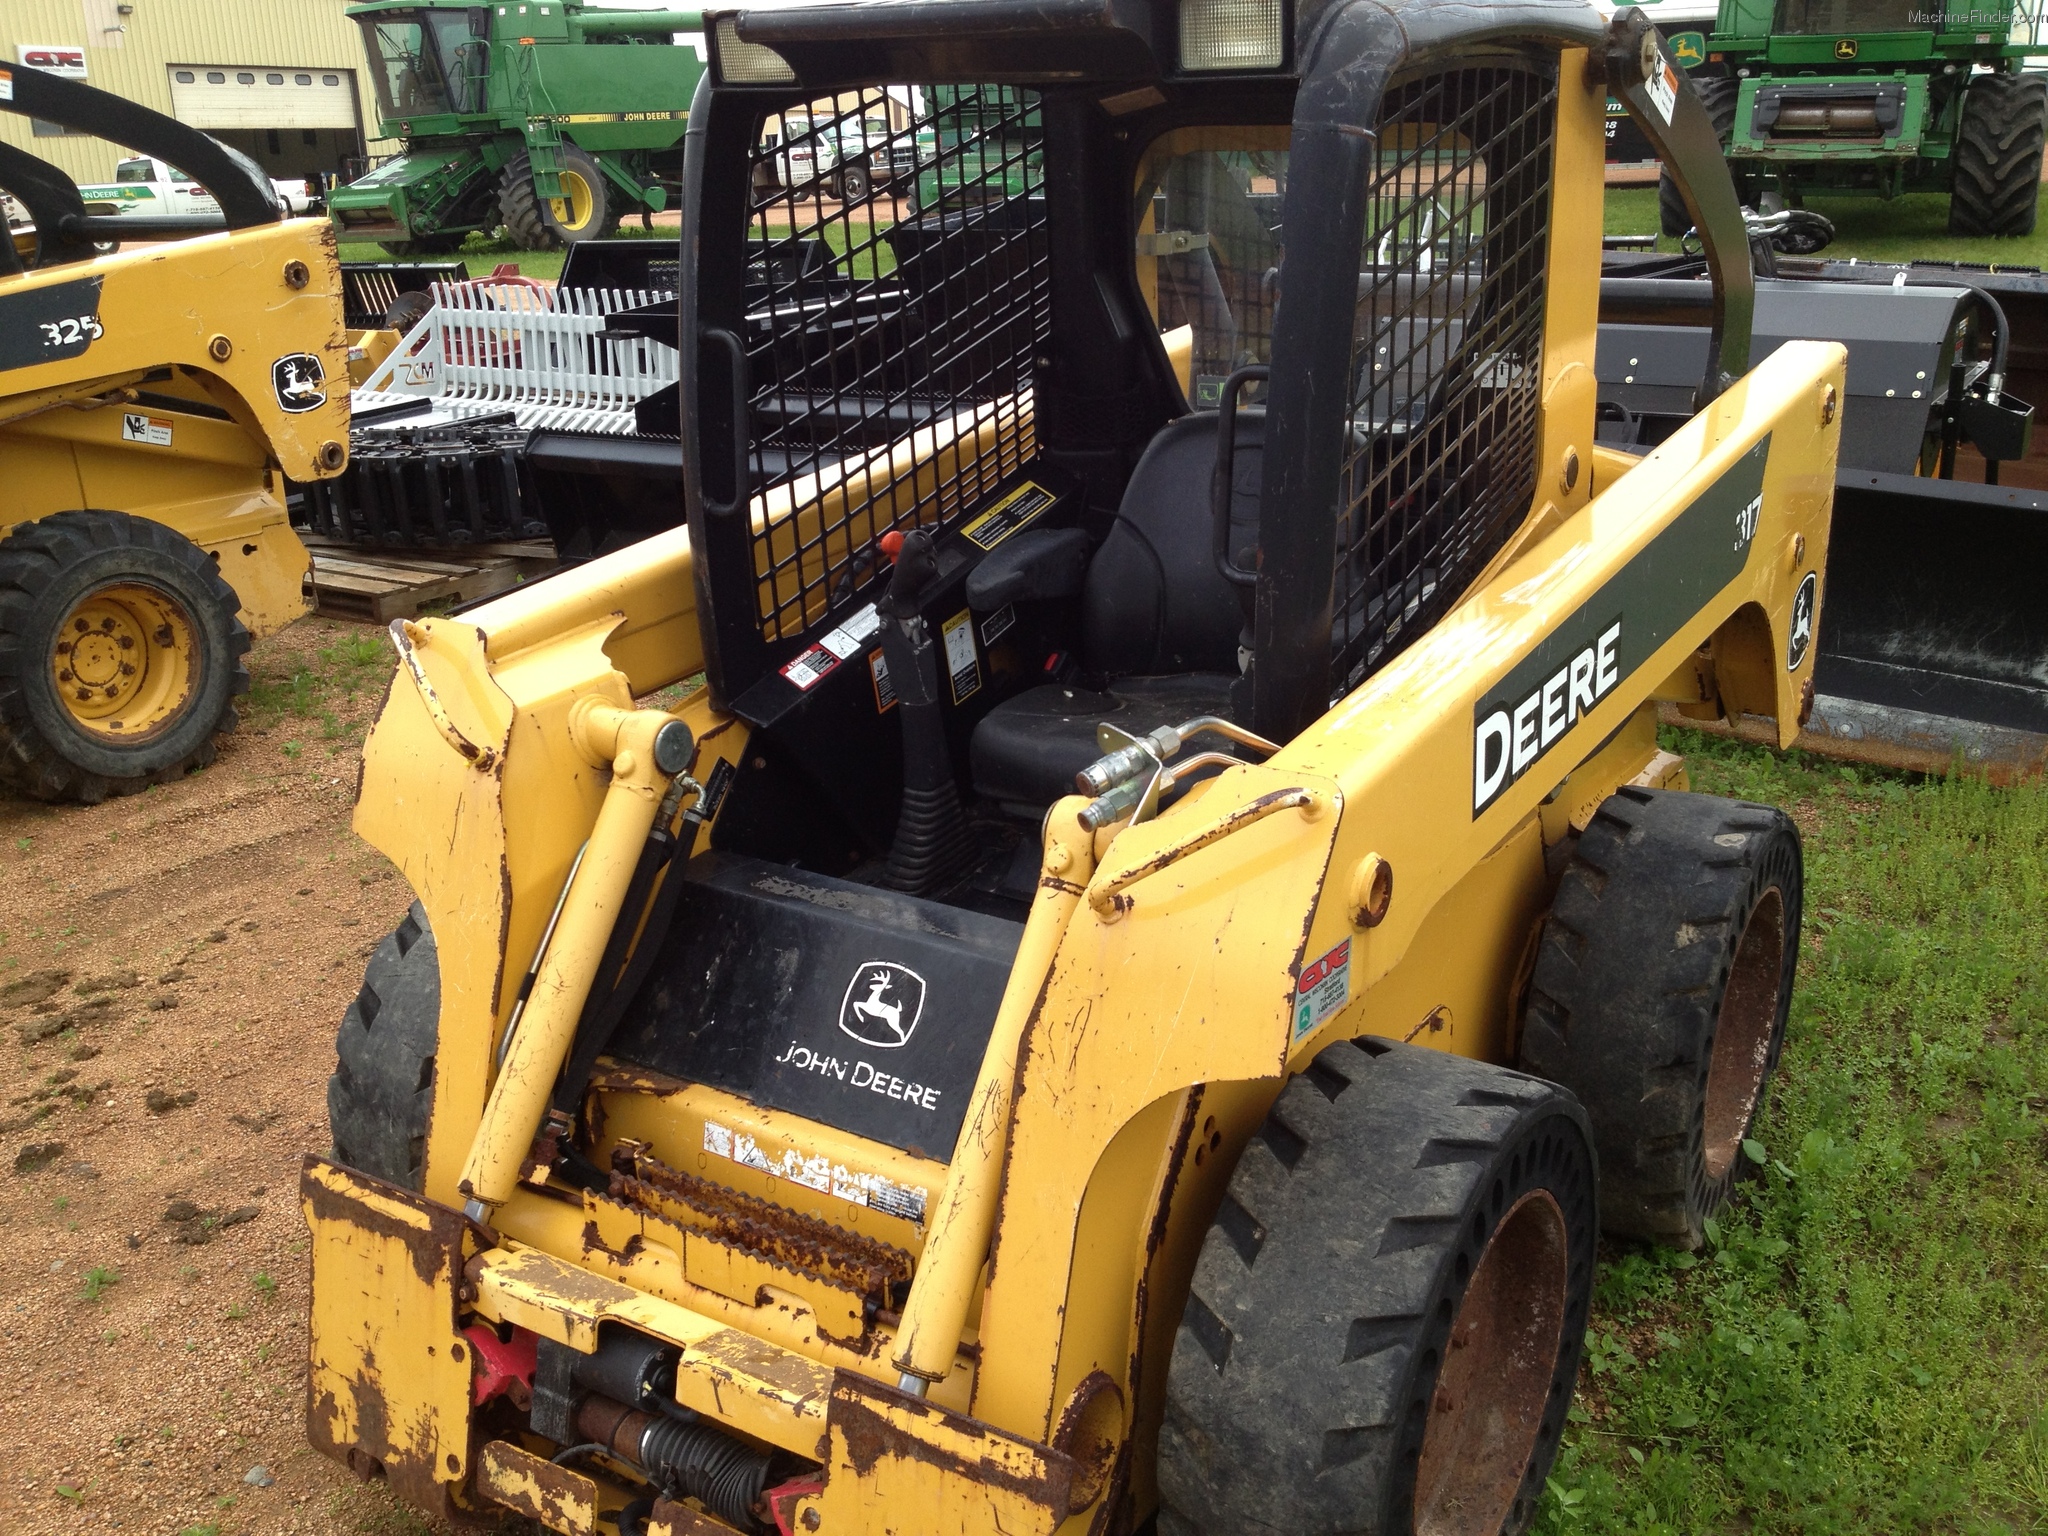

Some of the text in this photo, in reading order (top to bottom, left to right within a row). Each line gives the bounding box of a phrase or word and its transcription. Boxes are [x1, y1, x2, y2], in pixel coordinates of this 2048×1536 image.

[623, 111, 671, 121] JOHN DEERE
[94, 190, 120, 199] DEERE
[39, 315, 104, 346] 325
[1734, 492, 1764, 551] 317
[791, 649, 814, 668] DANGER
[1475, 621, 1621, 810] DEERE
[775, 1040, 942, 1111] JOHN DEERE
